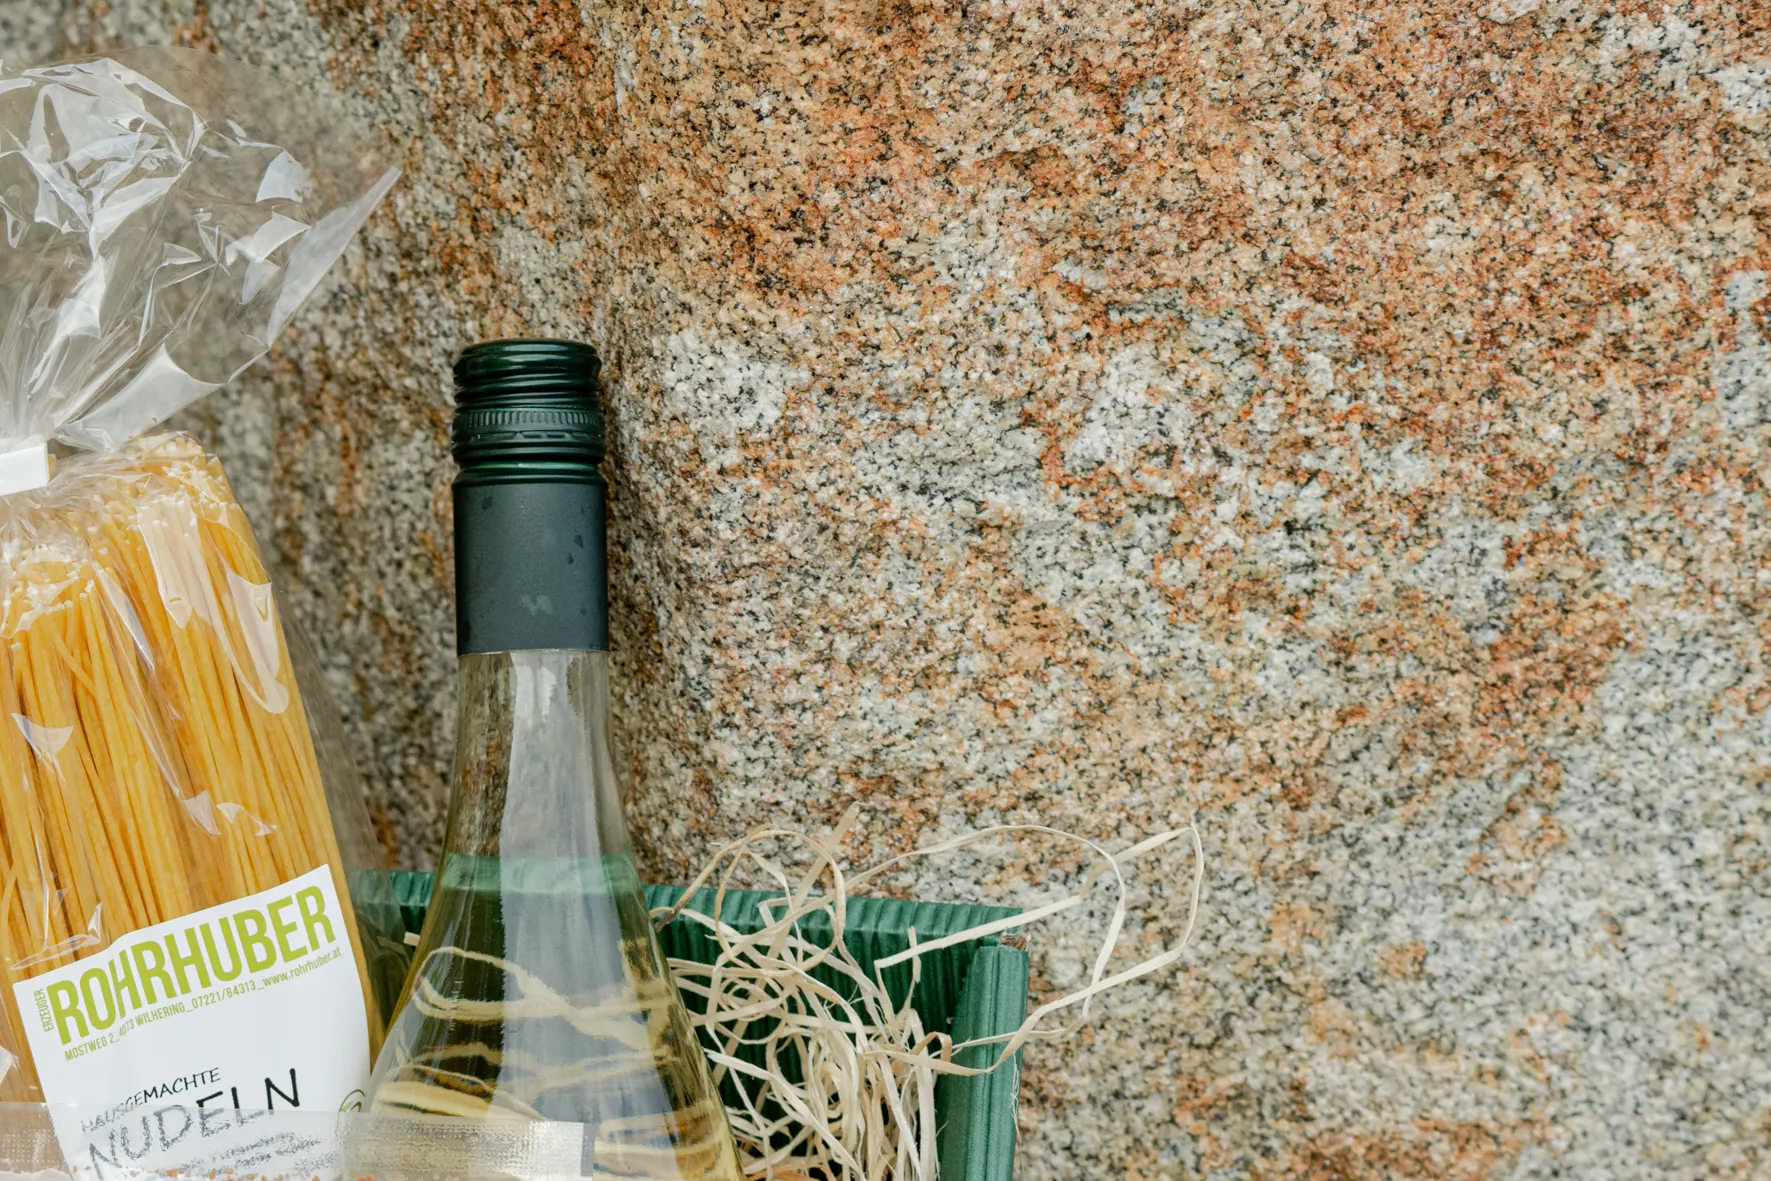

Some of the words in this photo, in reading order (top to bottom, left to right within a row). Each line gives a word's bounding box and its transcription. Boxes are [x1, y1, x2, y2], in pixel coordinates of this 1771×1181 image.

[46, 885, 336, 1045] ROHRHUBER
[34, 988, 55, 1033] ERZEUGER
[64, 1035, 108, 1061] MOSTWEG
[89, 1068, 300, 1181] NUDELN
